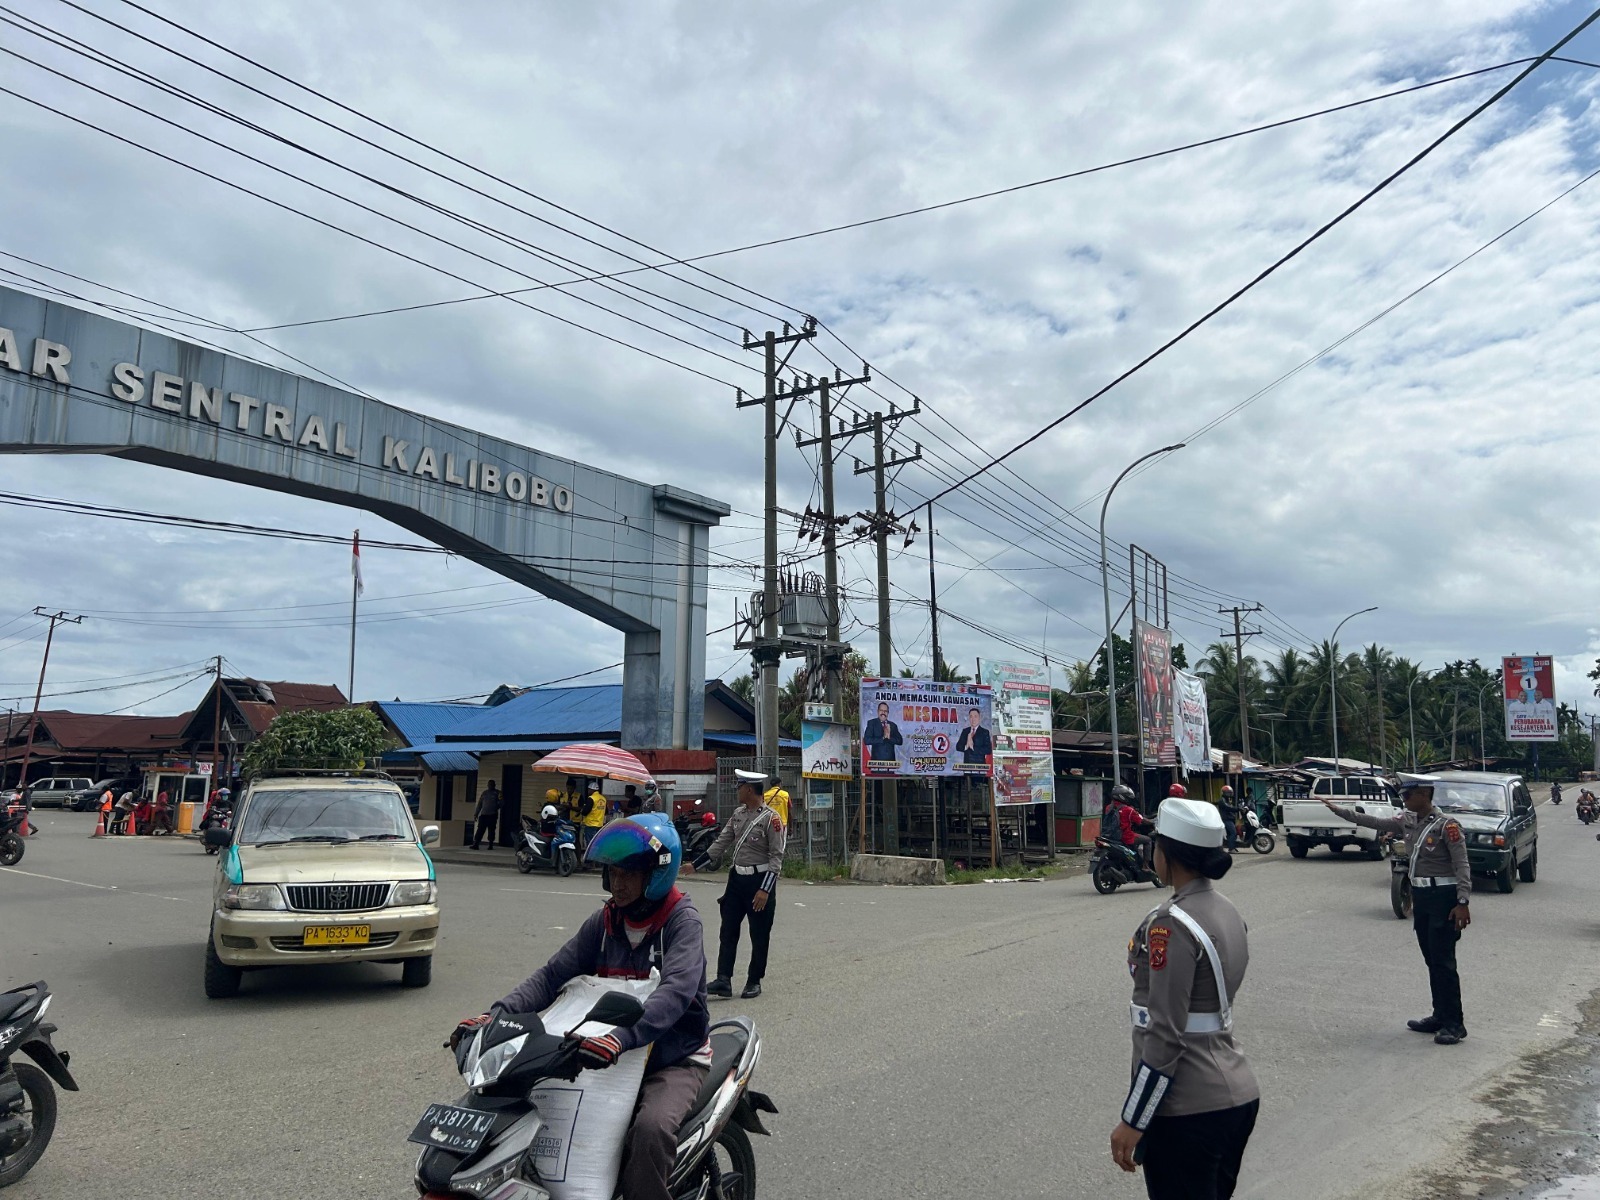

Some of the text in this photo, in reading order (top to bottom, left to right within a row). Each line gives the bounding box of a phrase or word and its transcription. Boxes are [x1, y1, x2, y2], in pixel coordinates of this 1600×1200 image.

[111, 362, 356, 458] SENTRAL
[383, 435, 573, 513] KALIBOBO
[1525, 677, 1532, 689] 1
[875, 692, 980, 706] ANDA MEMASUKI KAWASAN
[937, 736, 947, 751] 2
[811, 760, 849, 773] ANTON
[910, 757, 947, 765] LANJUTKAN
[306, 927, 319, 939] PA
[325, 926, 350, 938] 1633
